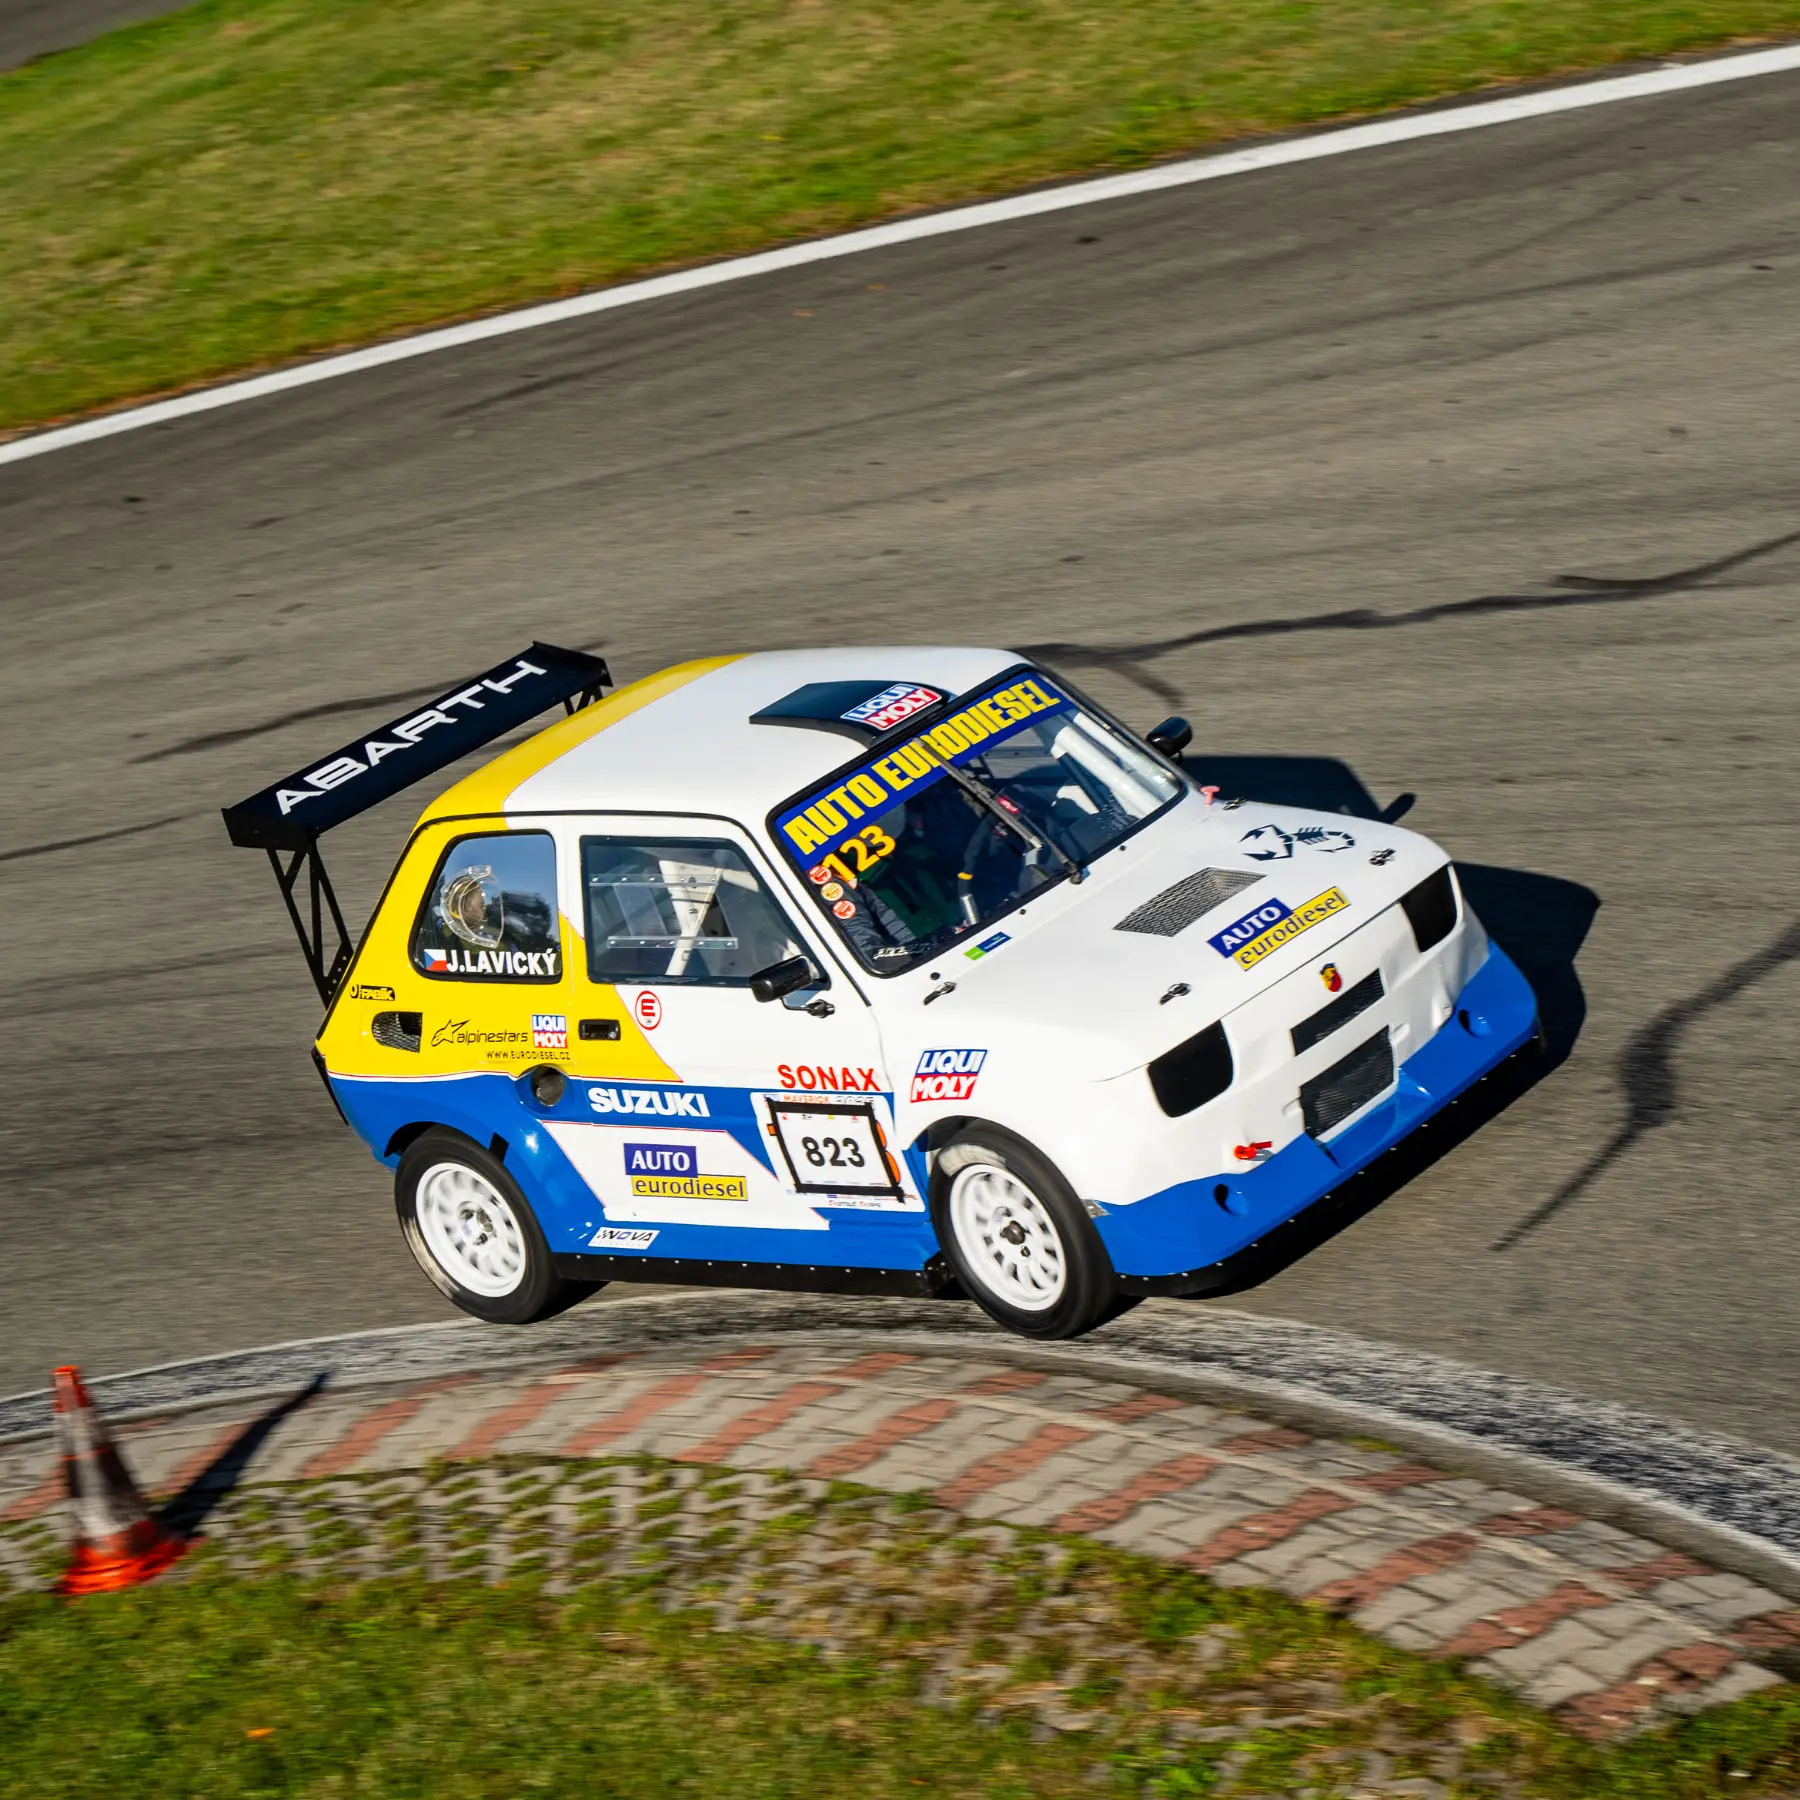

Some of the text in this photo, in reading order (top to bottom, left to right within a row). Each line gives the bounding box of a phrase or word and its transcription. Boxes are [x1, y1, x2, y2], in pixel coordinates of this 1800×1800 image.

[848, 684, 915, 719] LIQUI
[866, 689, 934, 728] MOLY
[275, 660, 547, 815] ABARTH
[783, 774, 888, 855] AUTO
[822, 825, 896, 884] 123
[1220, 906, 1282, 950] AUTO
[1240, 891, 1346, 964] eurodiesel
[446, 948, 557, 975] J.LAVICKÝ
[533, 1015, 566, 1031] LIQUI
[457, 1030, 528, 1045] alpinestars
[534, 1032, 567, 1047] MOLY
[917, 1050, 986, 1074] LIQUI
[777, 1064, 881, 1091] SONAX
[911, 1076, 978, 1100] MOLY
[588, 1087, 711, 1117] SUZUKI
[631, 1150, 690, 1171] AUTO
[802, 1136, 865, 1168] 823
[635, 1178, 744, 1198] eurodiesel
